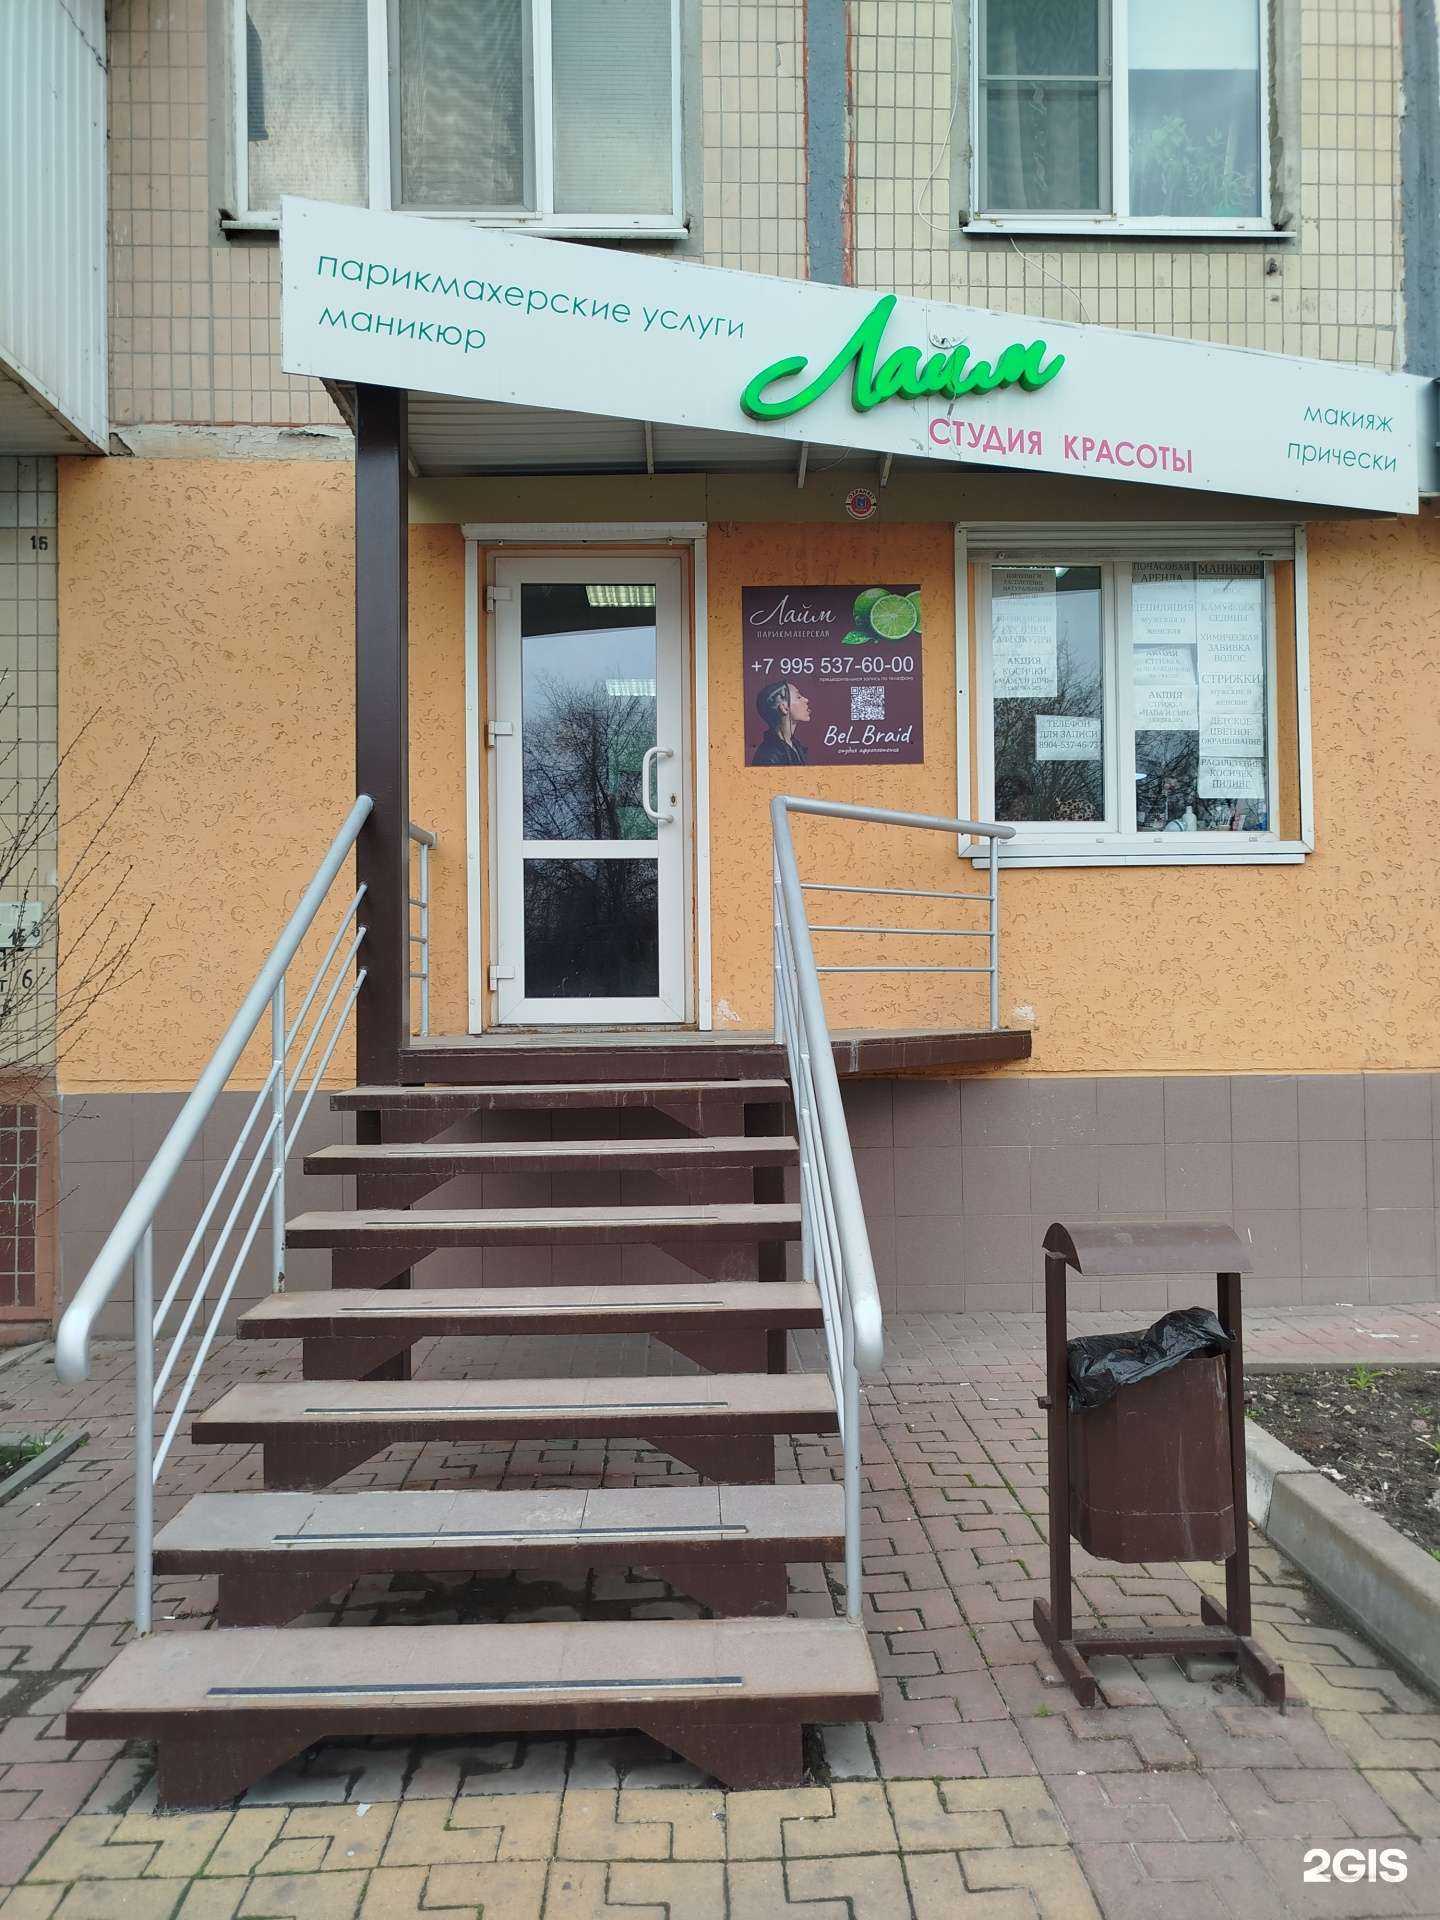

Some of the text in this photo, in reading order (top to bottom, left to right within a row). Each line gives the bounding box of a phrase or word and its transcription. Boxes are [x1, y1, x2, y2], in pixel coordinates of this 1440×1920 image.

[316, 254, 745, 340] парикмахерские услуги
[318, 306, 487, 353] маникюр
[1303, 404, 1394, 432] макияж
[928, 418, 1193, 474] СТУДИЯ КРАСОТЫ
[1287, 440, 1398, 473] прически
[1141, 573, 1183, 582] АРЕНДА
[1199, 563, 1260, 574] МАНИКЮР
[749, 594, 837, 626] Лайм
[757, 630, 830, 638] ПАРИКМАХЕРСКАЯ
[751, 656, 914, 674] +7 995 537-60-00
[1201, 674, 1261, 684] СТРИЖКИ
[1048, 720, 1090, 728] ТЕЛЕФОН
[824, 725, 913, 746] Bel_Braid
[1060, 730, 1098, 738] ЗАПИСИ
